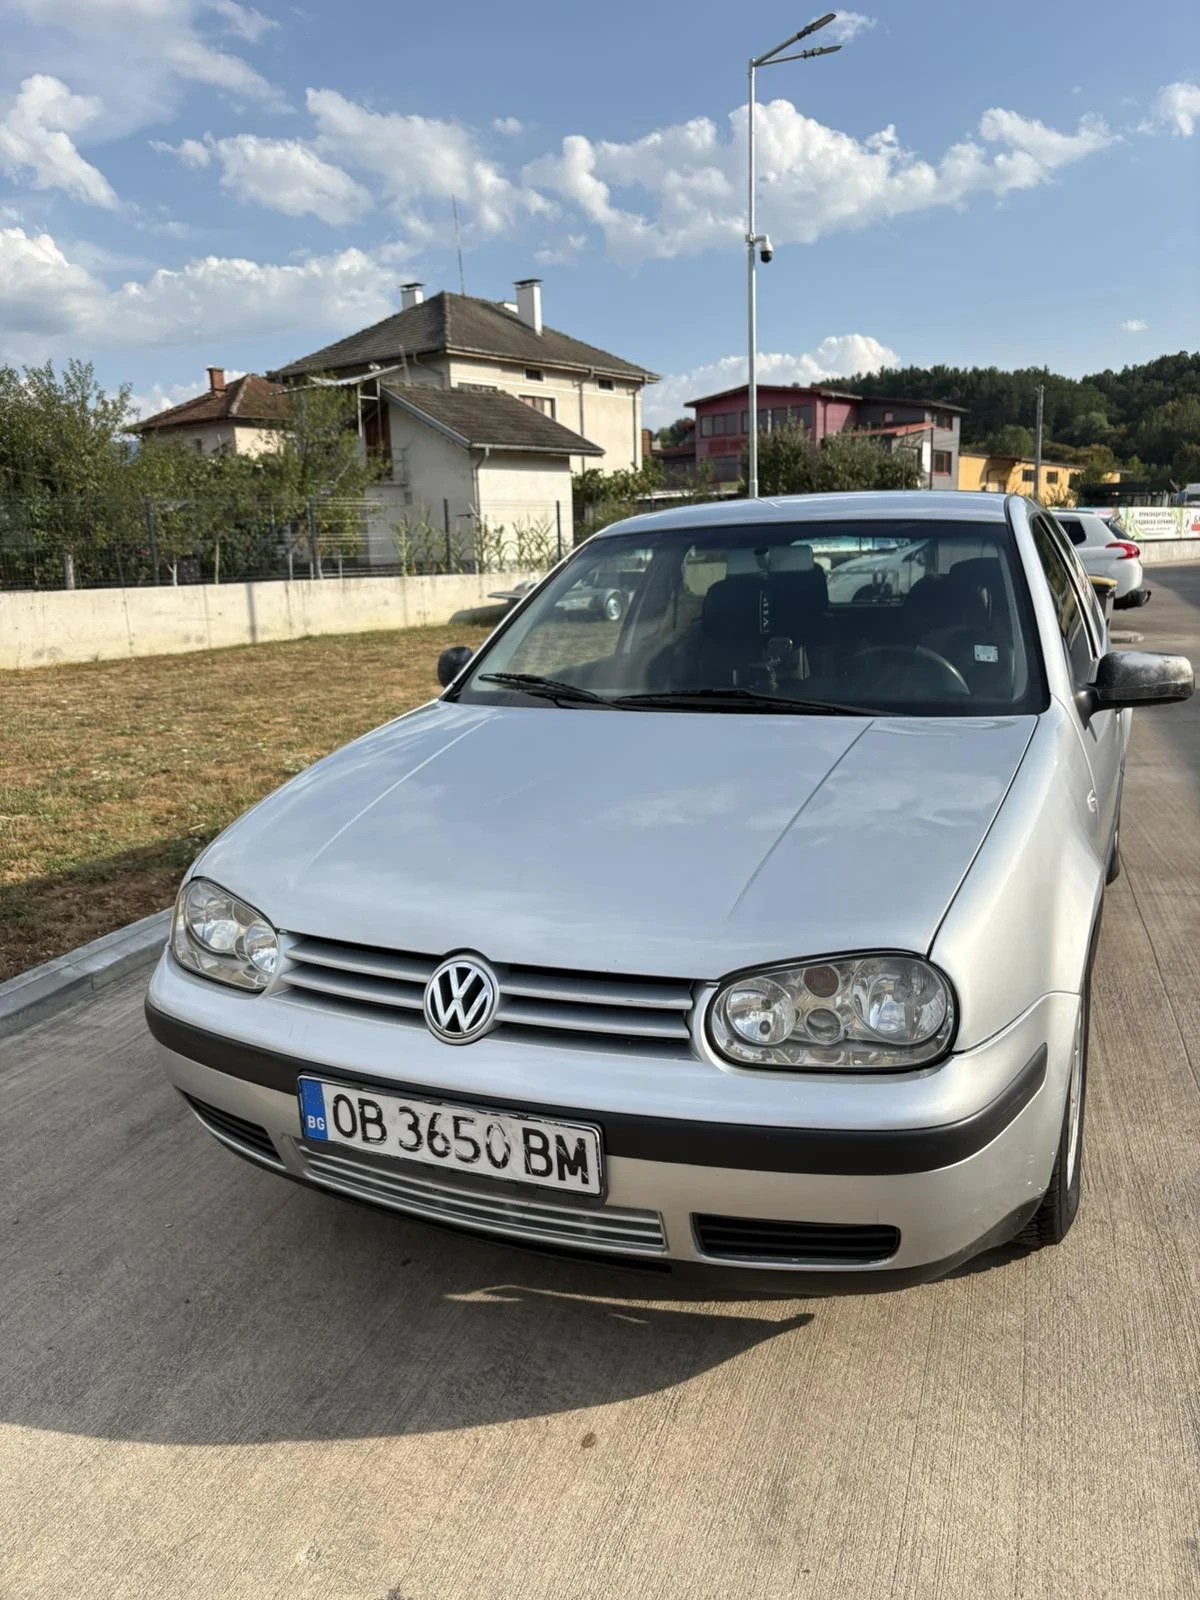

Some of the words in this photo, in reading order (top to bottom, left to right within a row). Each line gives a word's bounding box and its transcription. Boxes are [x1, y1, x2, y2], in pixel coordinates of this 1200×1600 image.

[307, 1116, 326, 1131] BG
[332, 1093, 387, 1145] OB
[397, 1106, 512, 1169] 3650
[521, 1127, 590, 1185] BM
